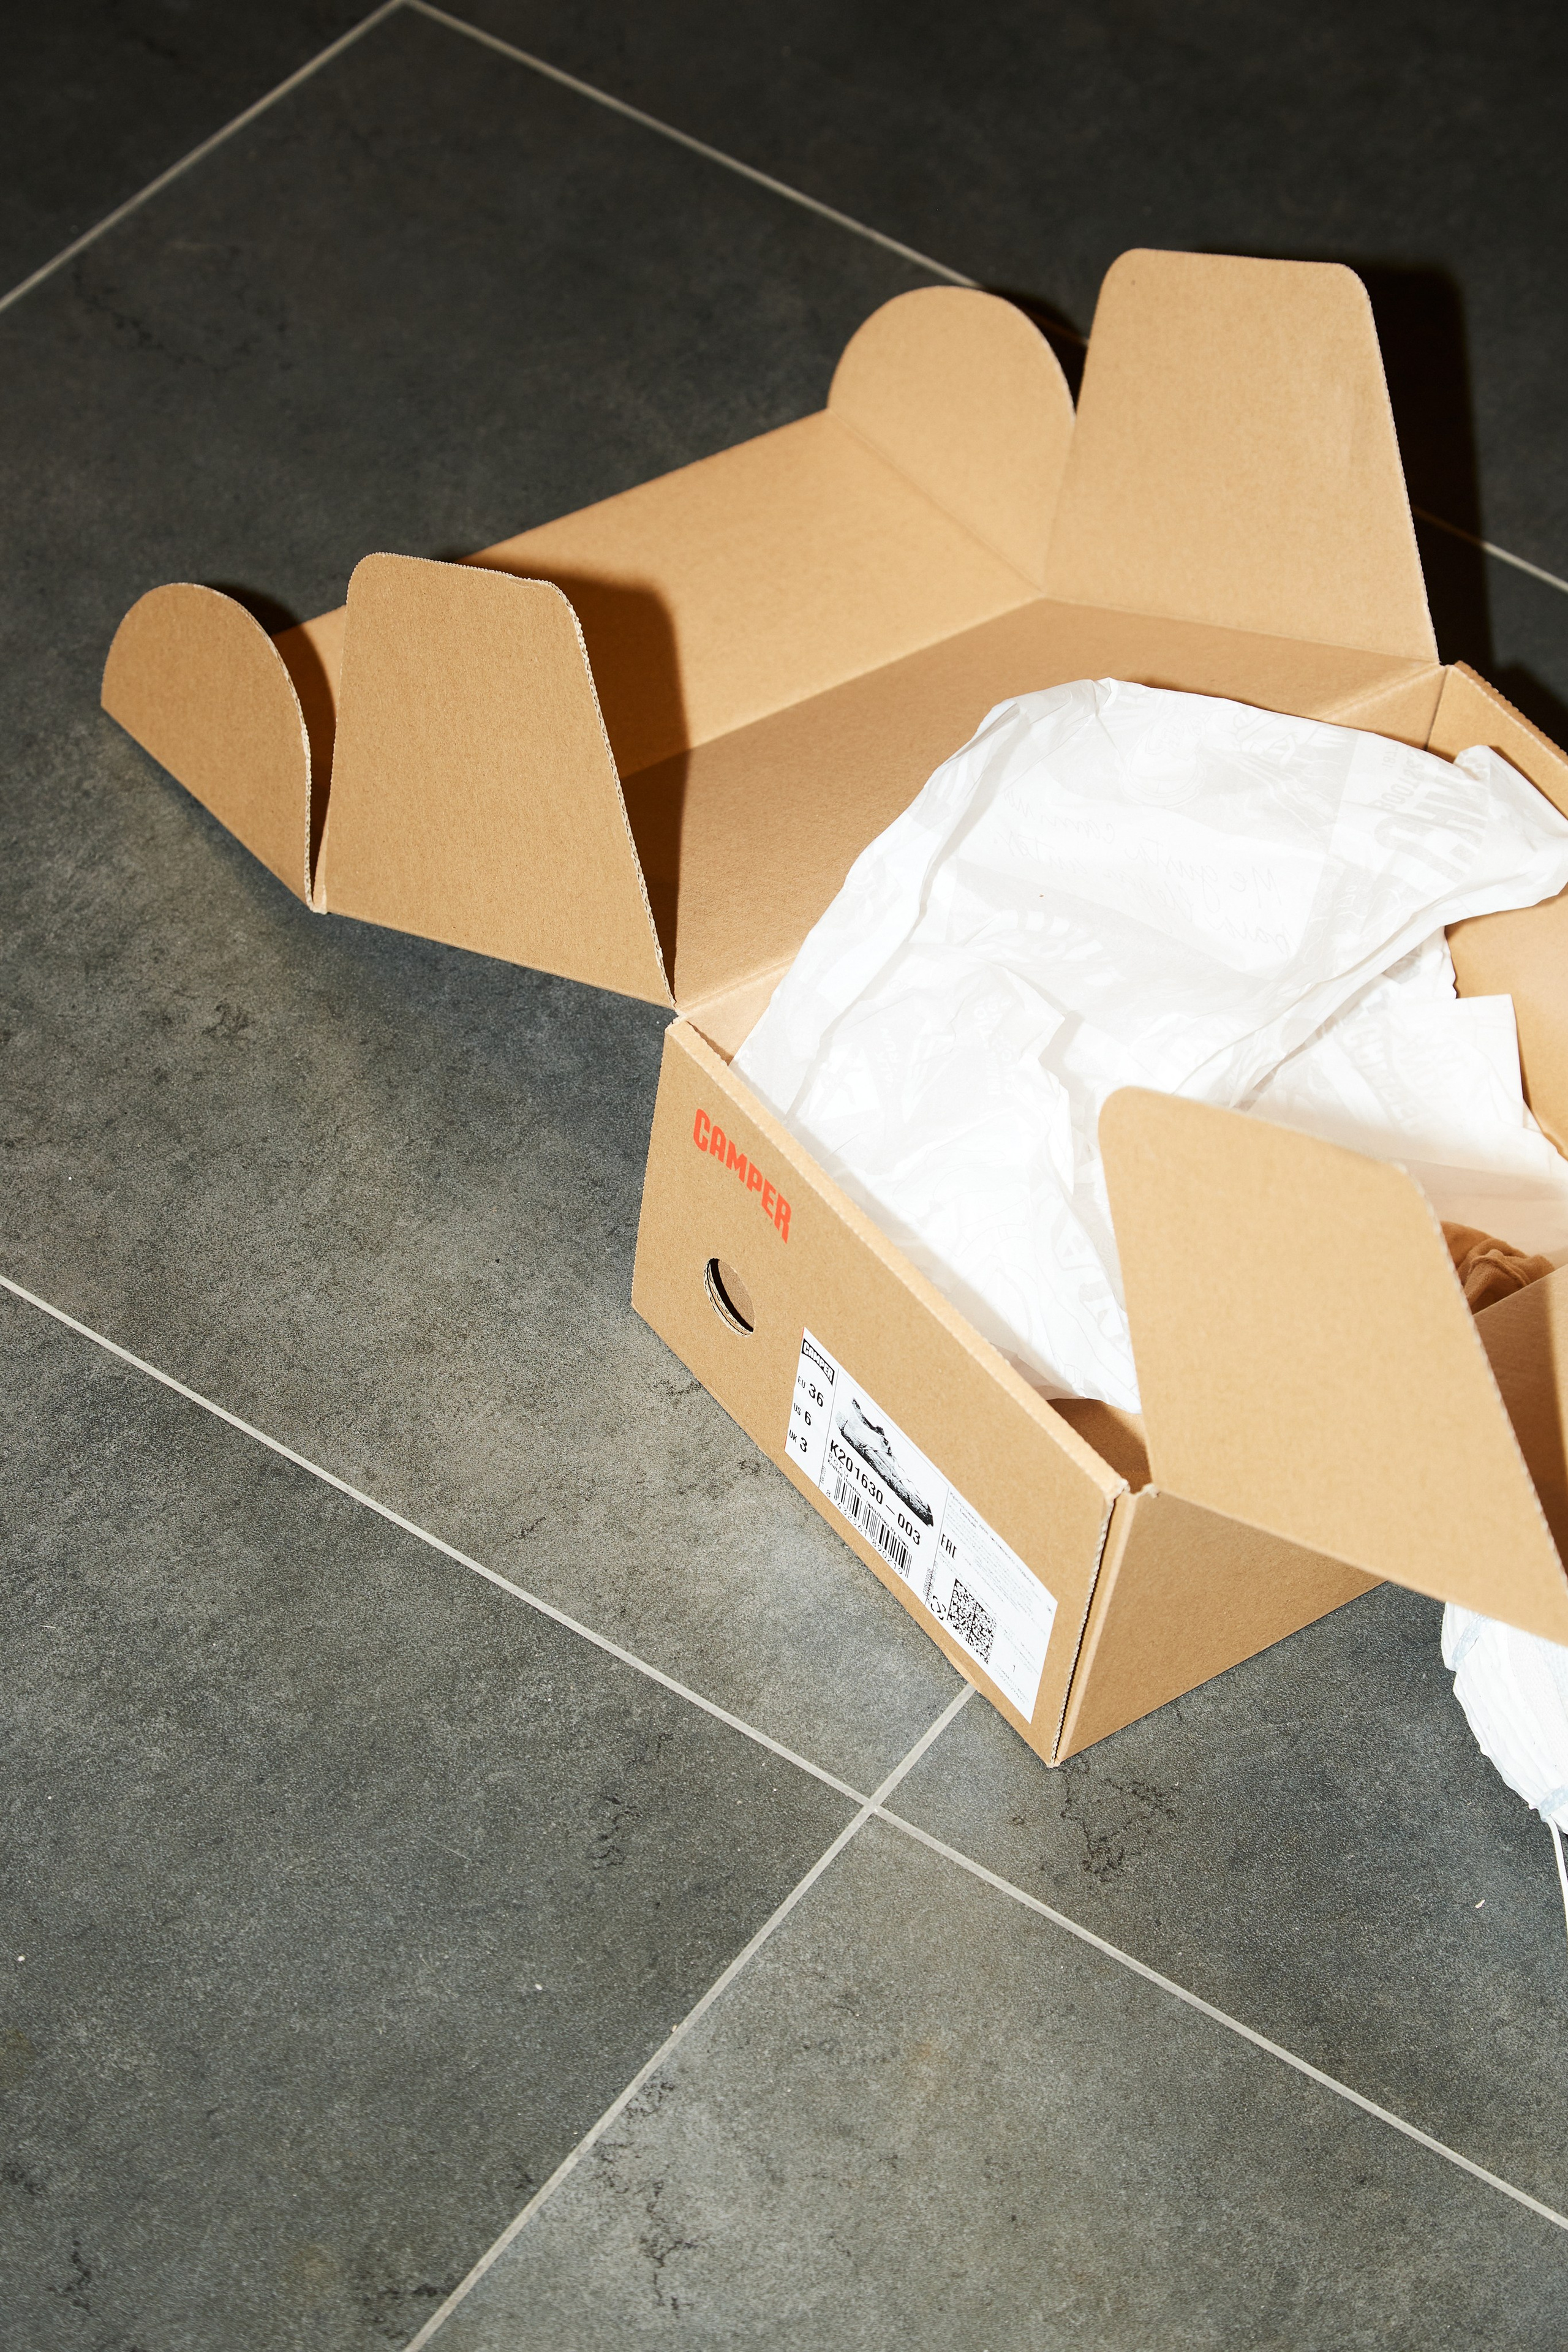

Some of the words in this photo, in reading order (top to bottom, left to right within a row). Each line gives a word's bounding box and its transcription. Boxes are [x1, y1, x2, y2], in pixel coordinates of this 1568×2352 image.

[693, 1109, 791, 1244] CAMPER
[802, 1338, 834, 1385] CAMPER
[798, 1376, 805, 1389] EU
[809, 1384, 824, 1407] 36
[794, 1403, 801, 1415] US
[805, 1411, 811, 1426] 6
[790, 1430, 797, 1442] UK
[800, 1437, 807, 1452] 3
[830, 1439, 883, 1504] K201630
[898, 1513, 920, 1545] 003
[837, 1501, 867, 1537] 432561
